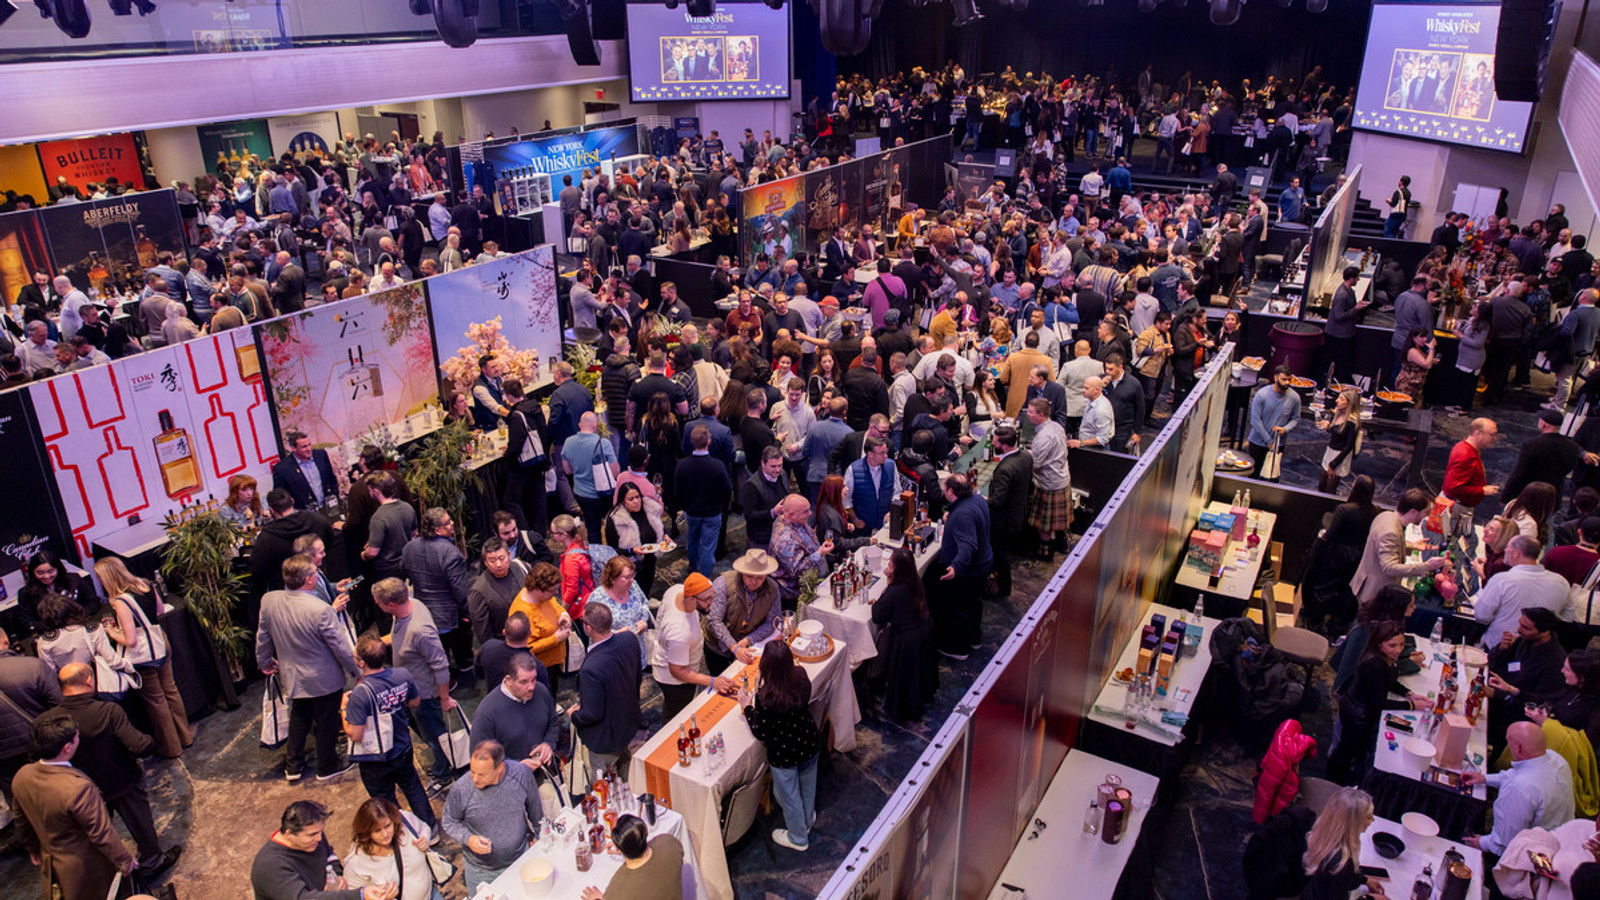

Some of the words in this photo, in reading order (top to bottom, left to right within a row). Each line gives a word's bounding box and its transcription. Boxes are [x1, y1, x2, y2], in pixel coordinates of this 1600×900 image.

[1426, 19, 1481, 36] WhiskyFest
[548, 145, 564, 154] NEW
[565, 141, 584, 151] YORK
[56, 147, 123, 168] BULLEIT
[532, 148, 600, 173] WhiskyFest
[83, 202, 138, 220] ABERFELDY
[131, 372, 155, 384] TOKI
[2, 535, 50, 556] Canadian
